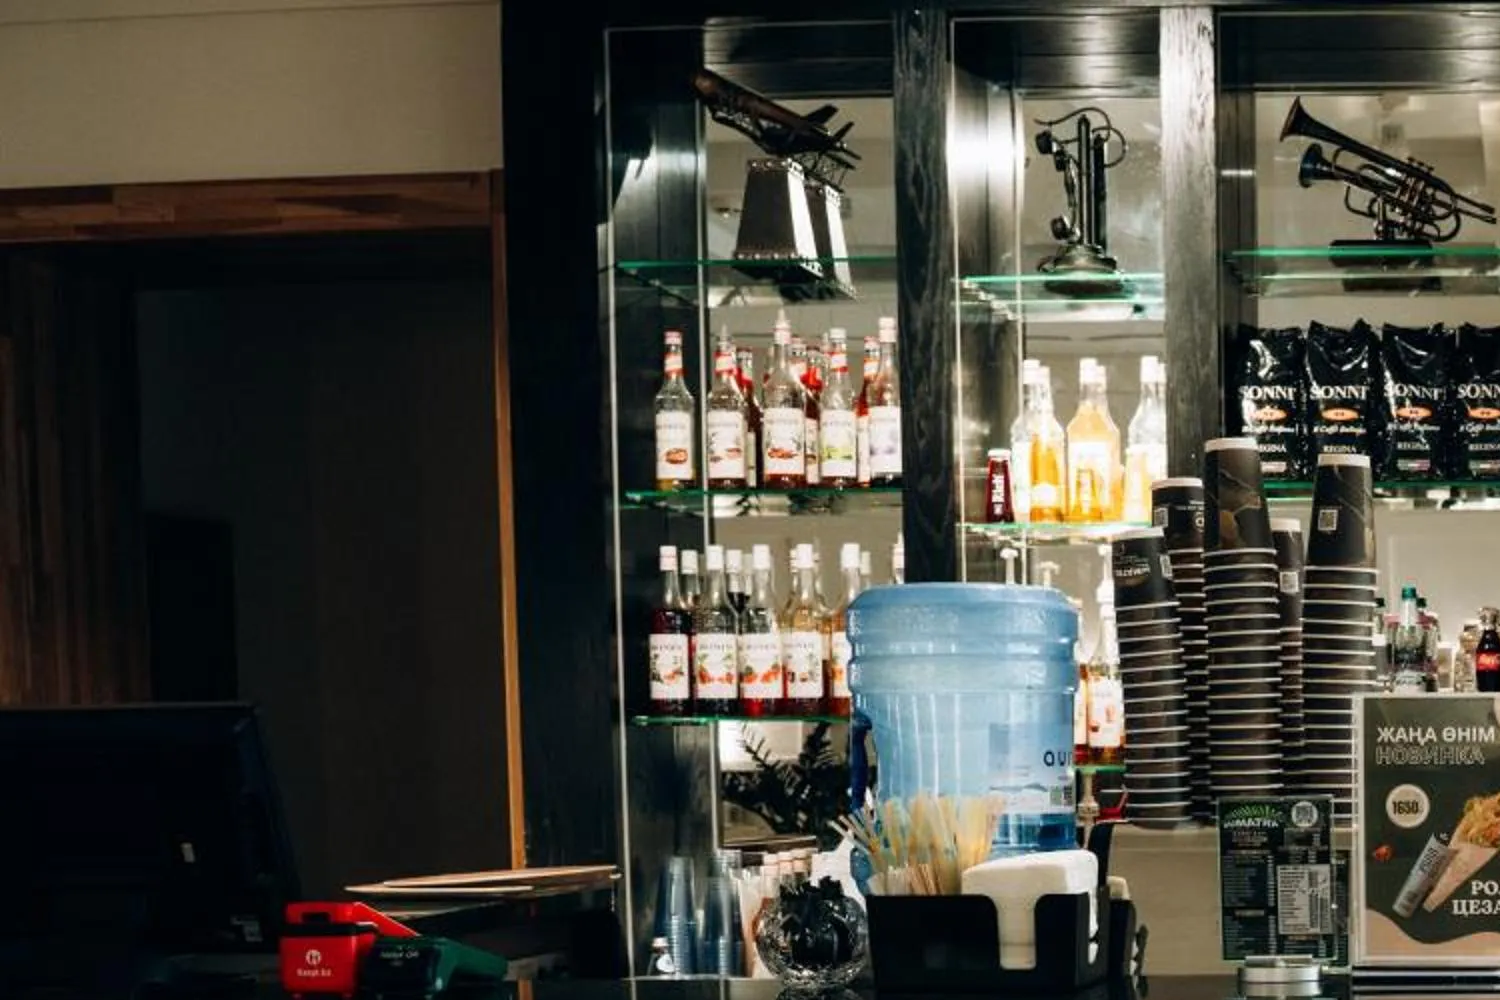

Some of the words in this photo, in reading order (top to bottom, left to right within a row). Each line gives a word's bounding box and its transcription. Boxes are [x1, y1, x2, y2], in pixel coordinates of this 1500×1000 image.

[1376, 725, 1437, 744] ЖАҢА
[1442, 725, 1496, 743] ӨНІМ
[1375, 746, 1486, 766] НОВИНКА
